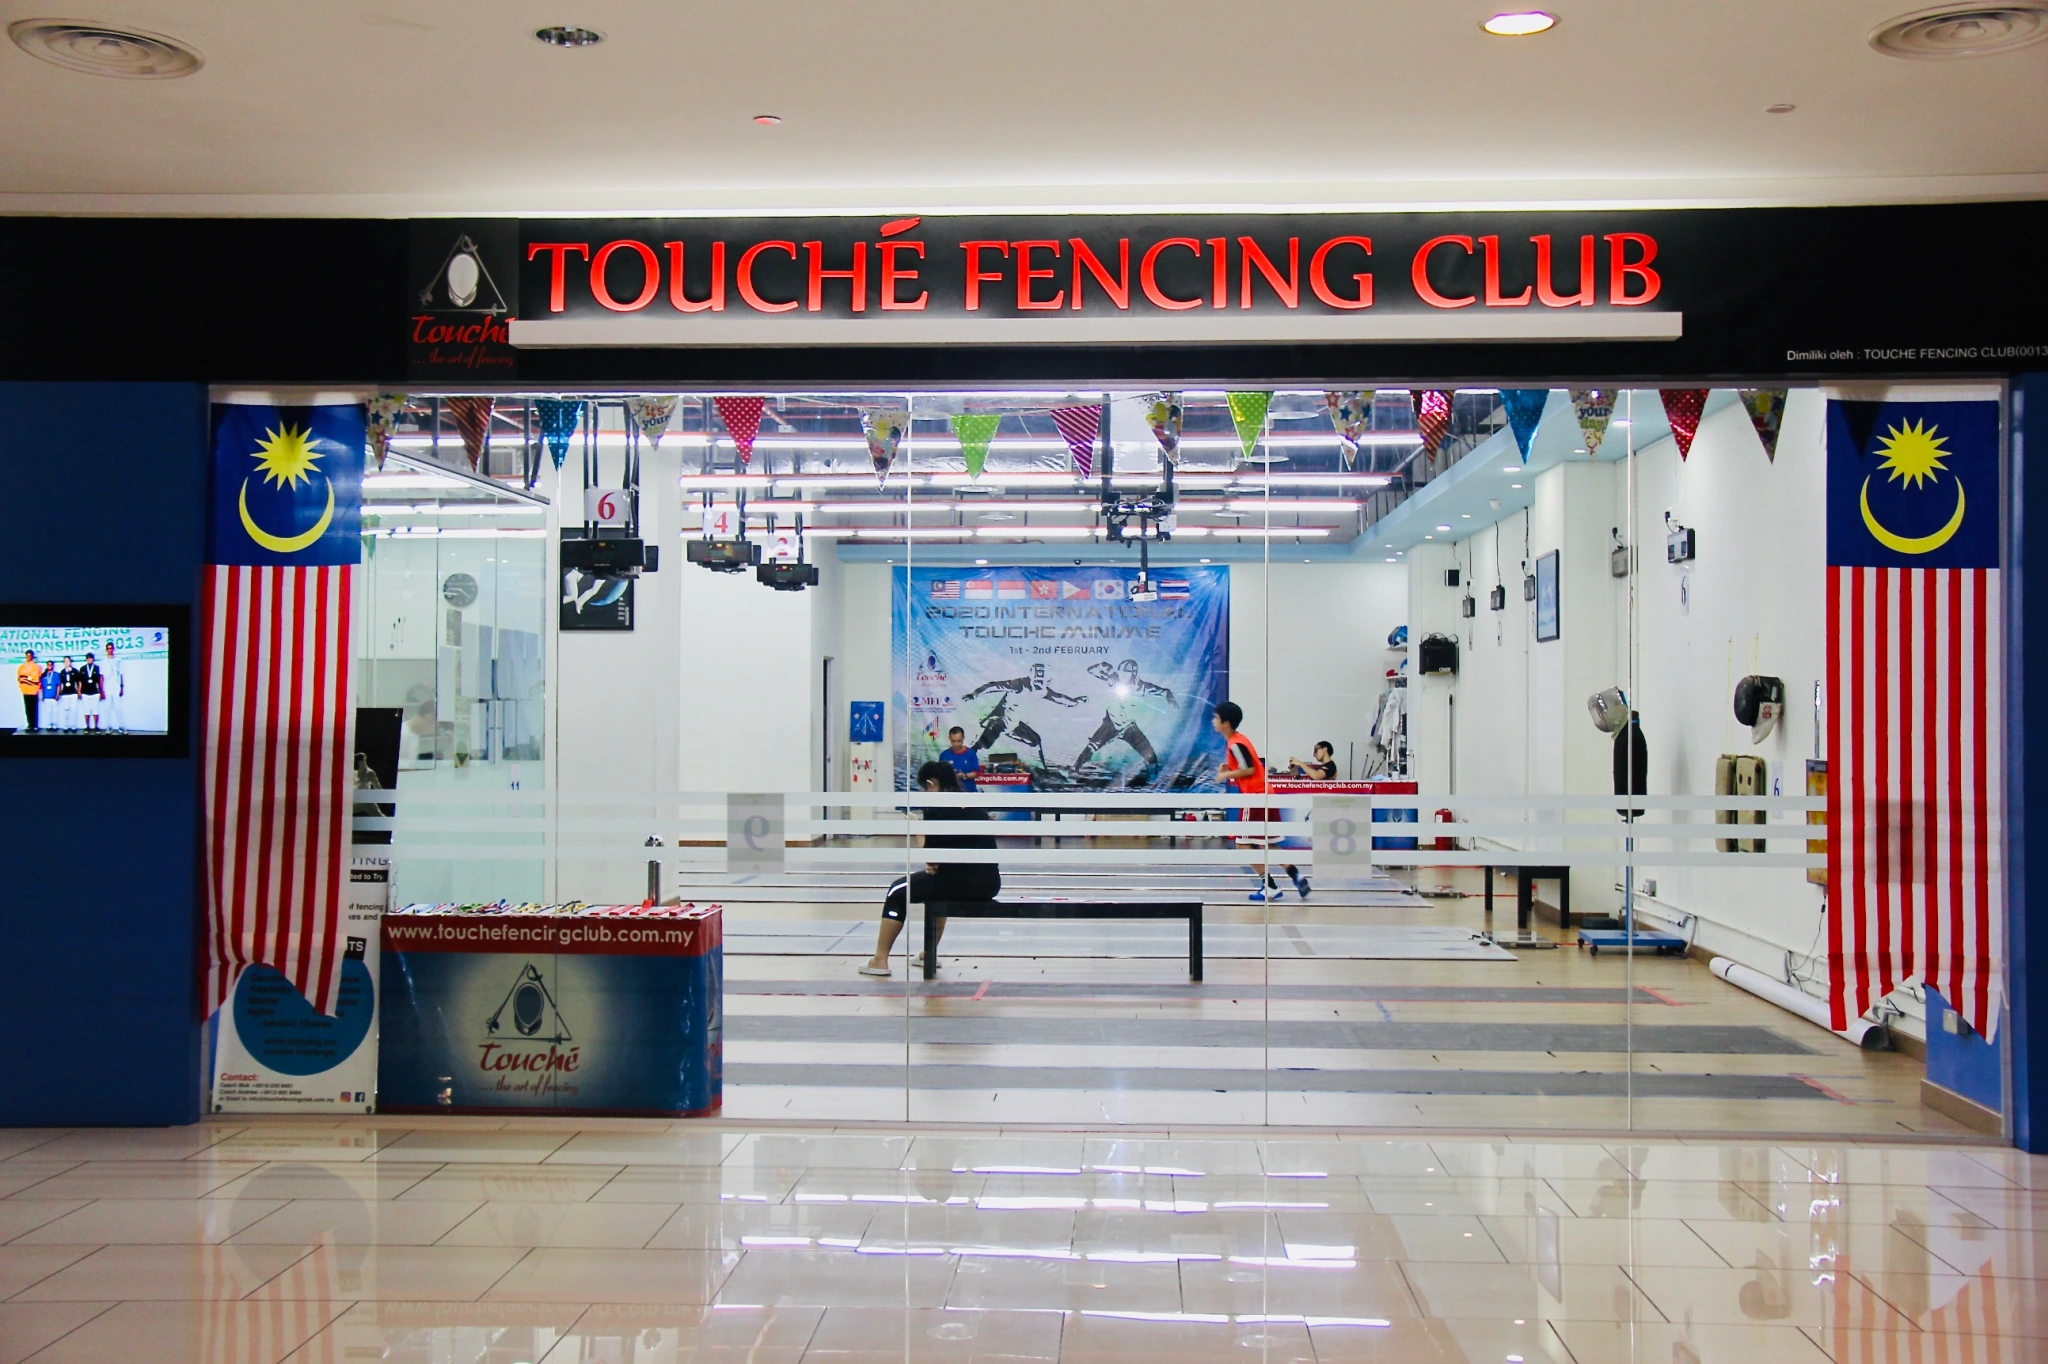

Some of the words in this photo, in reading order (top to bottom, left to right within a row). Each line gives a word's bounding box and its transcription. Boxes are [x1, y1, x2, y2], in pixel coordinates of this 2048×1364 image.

[527, 216, 930, 315] TOUCHÉ
[958, 235, 1375, 312] FENCING
[1409, 231, 1663, 311] CLUB
[1786, 350, 1827, 361] Dimiliki
[1829, 349, 1854, 360] oleh
[1864, 348, 1916, 360] TOUCHE
[1920, 347, 1978, 359] FENCING
[1579, 406, 1612, 420] your
[641, 415, 670, 431] your
[597, 492, 616, 520] 6
[713, 511, 728, 533] 4
[1681, 575, 1687, 606] 6
[925, 605, 991, 620] 2020
[994, 604, 1193, 620] INTERNATIONAL
[958, 625, 1056, 639] TOUCHE
[1060, 625, 1162, 639] MINIME
[1009, 646, 1023, 655] 1st
[1032, 646, 1052, 655] 2nd
[1054, 646, 1110, 655] FEBRUARY
[1271, 780, 1374, 790] www.touchefencingclub.com.my
[1328, 818, 1357, 856] 8
[356, 903, 384, 912] fencing
[363, 913, 378, 921] and
[478, 1042, 580, 1073] Touché
[220, 1072, 259, 1082] Contact:
[496, 1075, 511, 1091] the
[513, 1080, 529, 1091] art
[530, 1074, 545, 1096] of
